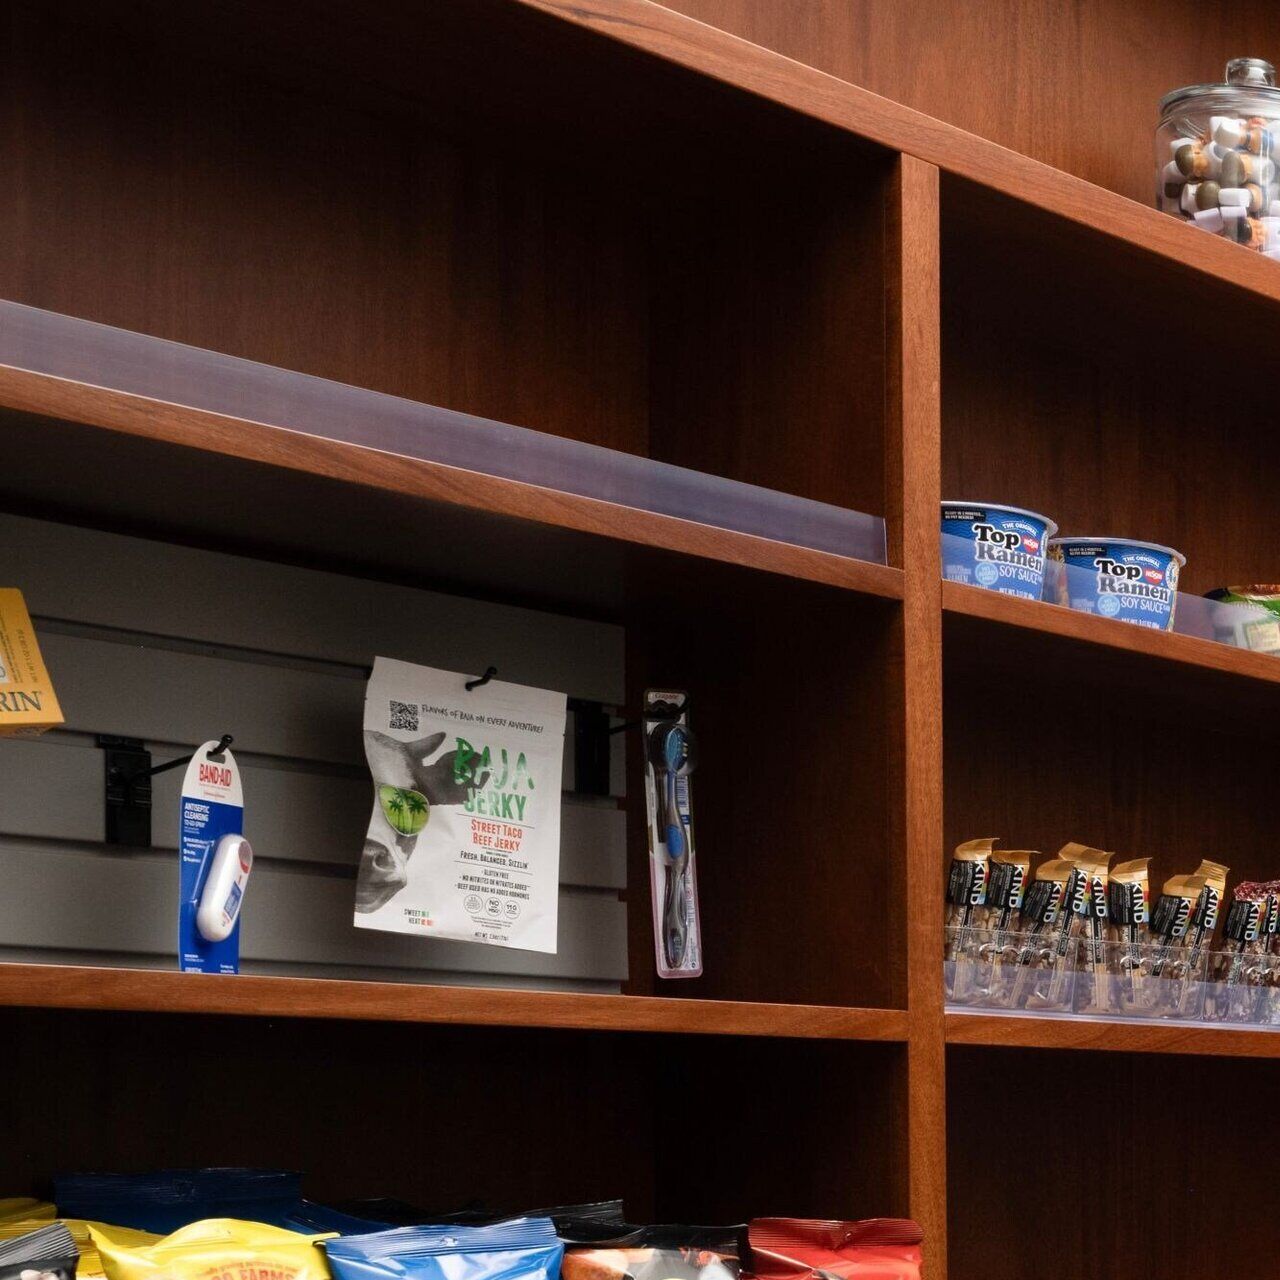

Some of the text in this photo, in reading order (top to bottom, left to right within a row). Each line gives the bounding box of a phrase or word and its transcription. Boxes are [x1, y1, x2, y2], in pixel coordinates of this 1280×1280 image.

[972, 523, 1021, 551] Top
[975, 541, 1044, 575] Ramen
[1000, 565, 1017, 579] SOY
[1018, 569, 1040, 585] SAUCE
[1093, 557, 1142, 581] Top
[1096, 576, 1171, 603] Ramen
[1121, 597, 1140, 609] SOY
[1140, 600, 1164, 614] SAUCE
[421, 704, 448, 717] FLAVORS
[450, 710, 459, 718] OF
[476, 715, 485, 723] ON
[199, 763, 232, 787] BAND-AID
[454, 737, 535, 790] BAJA
[464, 787, 527, 821] JERKY
[471, 819, 522, 839] STREET TACO
[473, 832, 521, 852] BEEF JERKY
[969, 859, 986, 906] KIND
[1008, 864, 1025, 909] KIND
[1072, 869, 1089, 913] KIND
[1092, 875, 1106, 918] KIND
[1043, 881, 1063, 923] KIND
[1132, 882, 1144, 924] KIND
[1171, 897, 1191, 938] KIND
[1203, 887, 1219, 929] KIND
[1268, 895, 1278, 933] KIND
[1244, 900, 1260, 942] KIND
